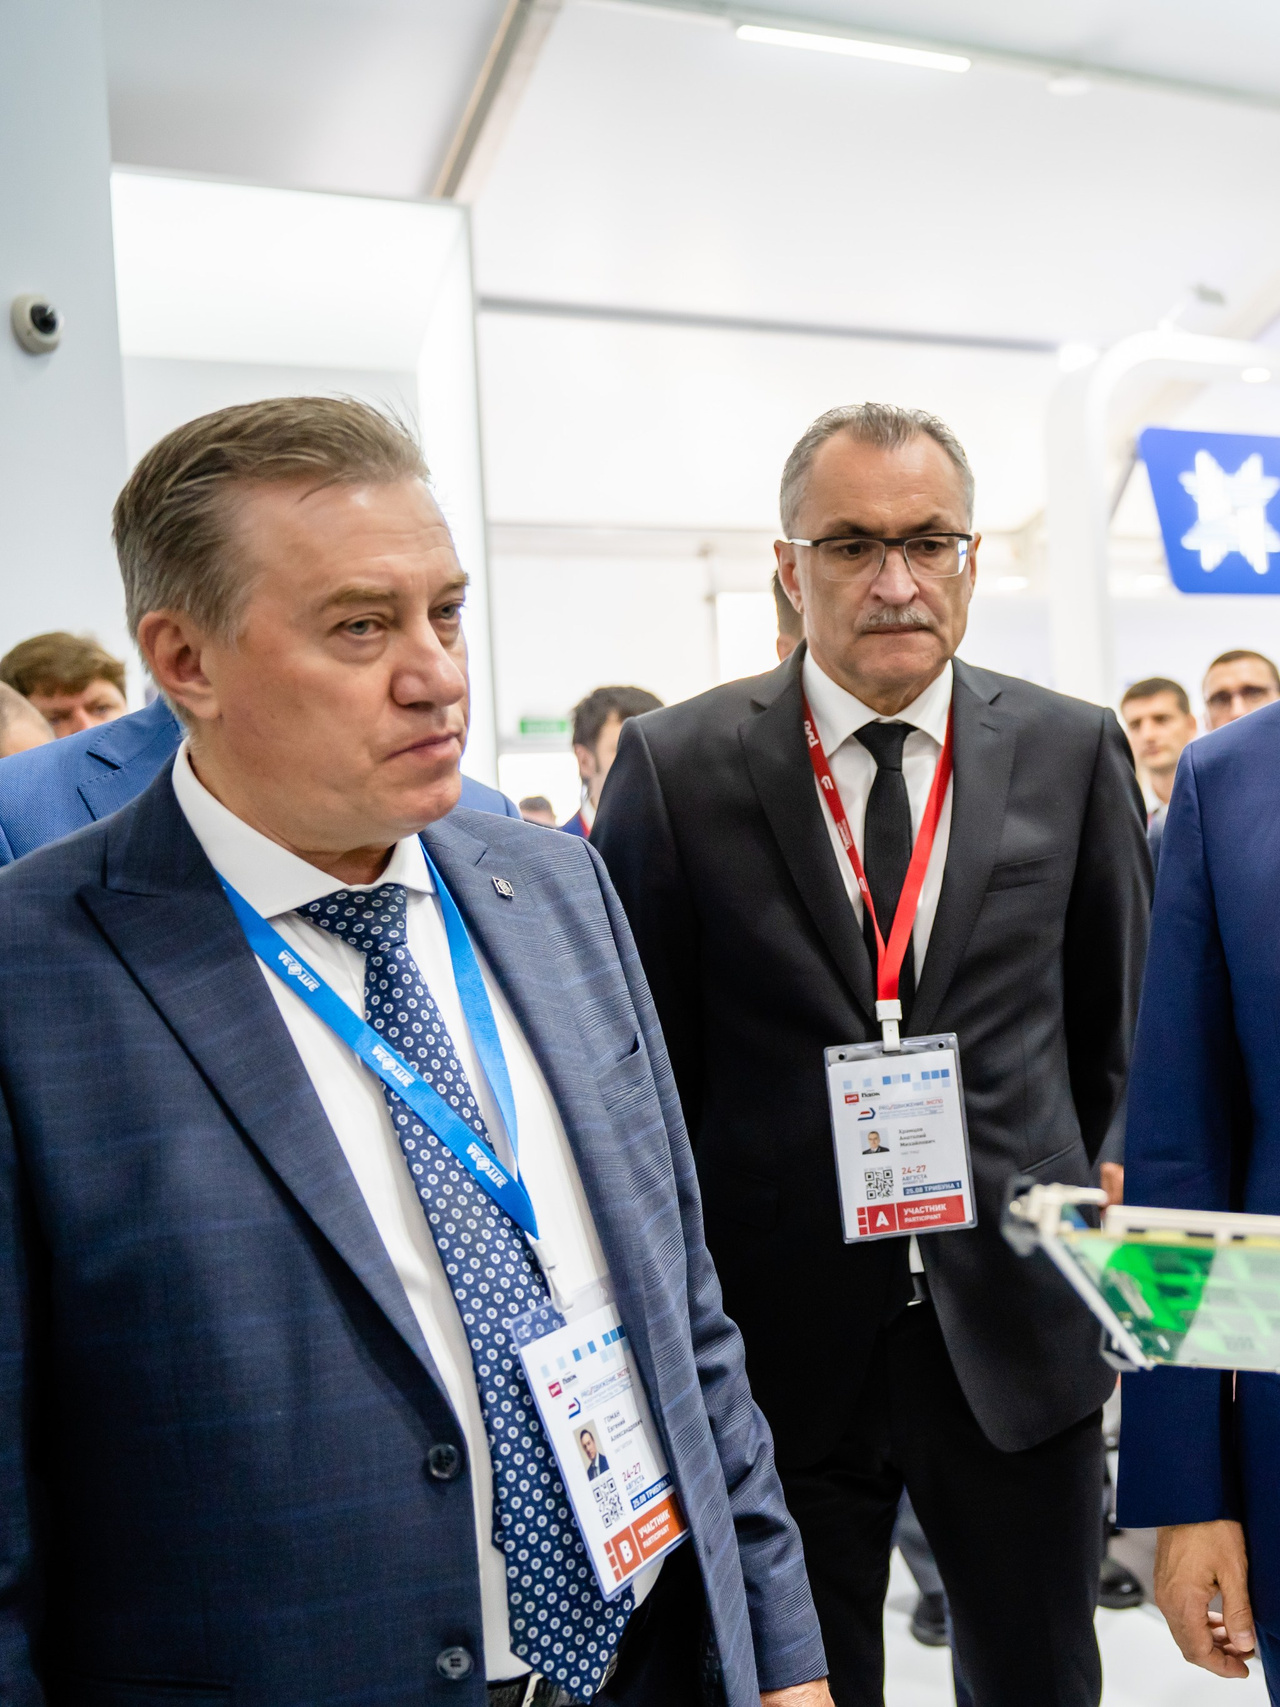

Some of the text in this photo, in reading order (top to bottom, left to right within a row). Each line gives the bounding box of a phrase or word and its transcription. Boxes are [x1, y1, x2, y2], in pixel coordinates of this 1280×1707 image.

[901, 1165, 926, 1175] 24-27
[924, 1183, 955, 1193] ТРИБУНА
[903, 1203, 947, 1216] УЧАСТНИК
[638, 1508, 670, 1539] УЧАСТНИК
